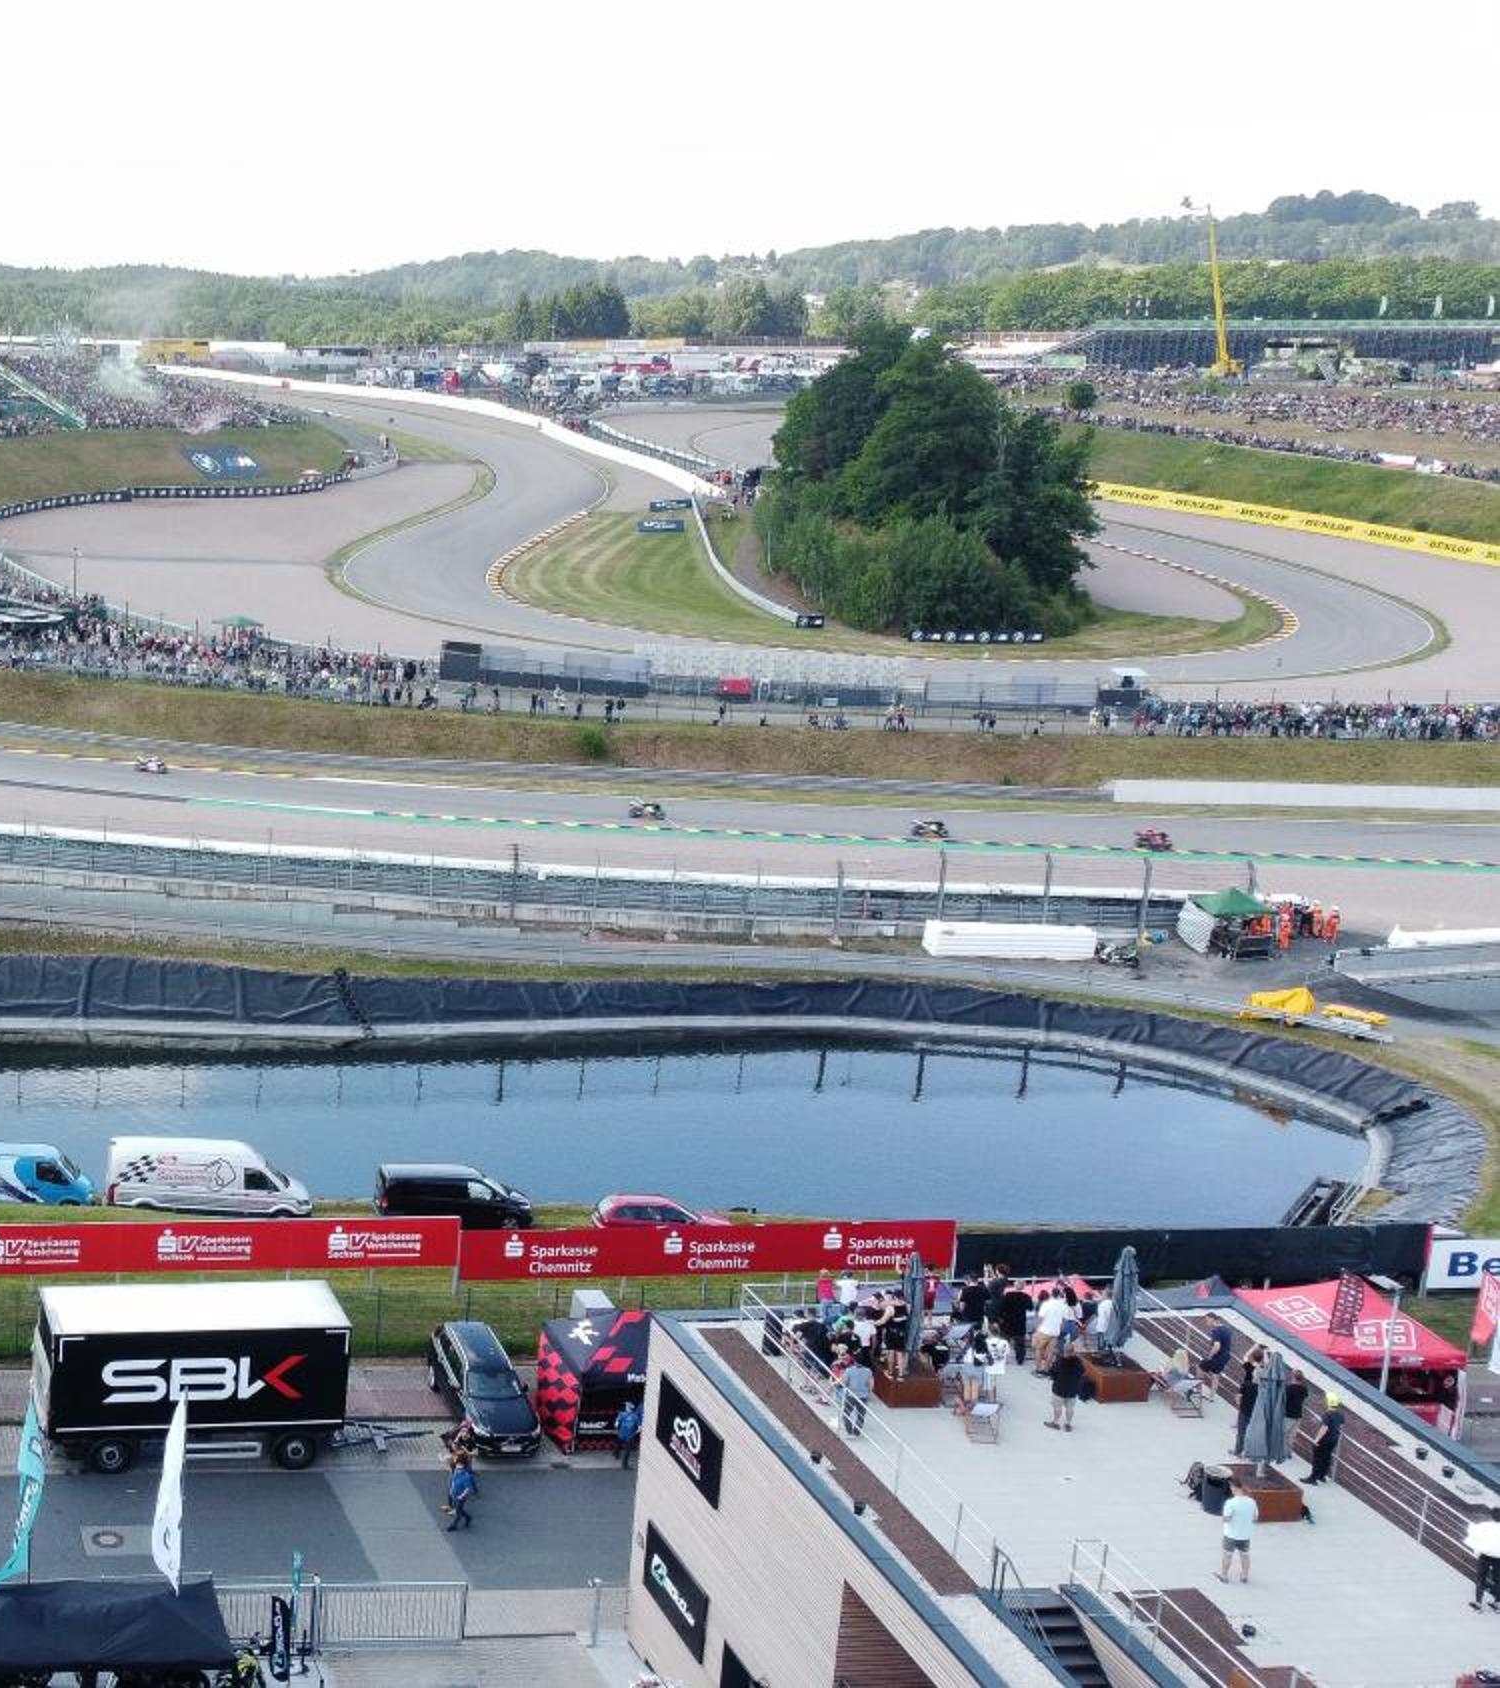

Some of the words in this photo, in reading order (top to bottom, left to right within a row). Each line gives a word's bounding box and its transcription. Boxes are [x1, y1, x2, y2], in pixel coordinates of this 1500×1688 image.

[1110, 489, 1159, 501] DUNLOP
[1175, 499, 1224, 511] DUNLOP
[1240, 508, 1290, 521] DUNLOP
[1304, 518, 1354, 532] DUNLOP
[1367, 529, 1415, 543] DUNLOP
[1428, 540, 1474, 554] DUNLOP
[27, 1239, 81, 1248] Sparkassen
[200, 1235, 252, 1244] Sparkassen
[370, 1232, 422, 1242] Sparkassen
[848, 1236, 915, 1250] Sparkasse
[530, 1244, 598, 1258] Sparkasse
[689, 1240, 756, 1254] Sparkasse
[528, 1261, 592, 1274] Chemnitz
[687, 1257, 750, 1270] Chemnitz
[101, 1354, 308, 1404] SBK
